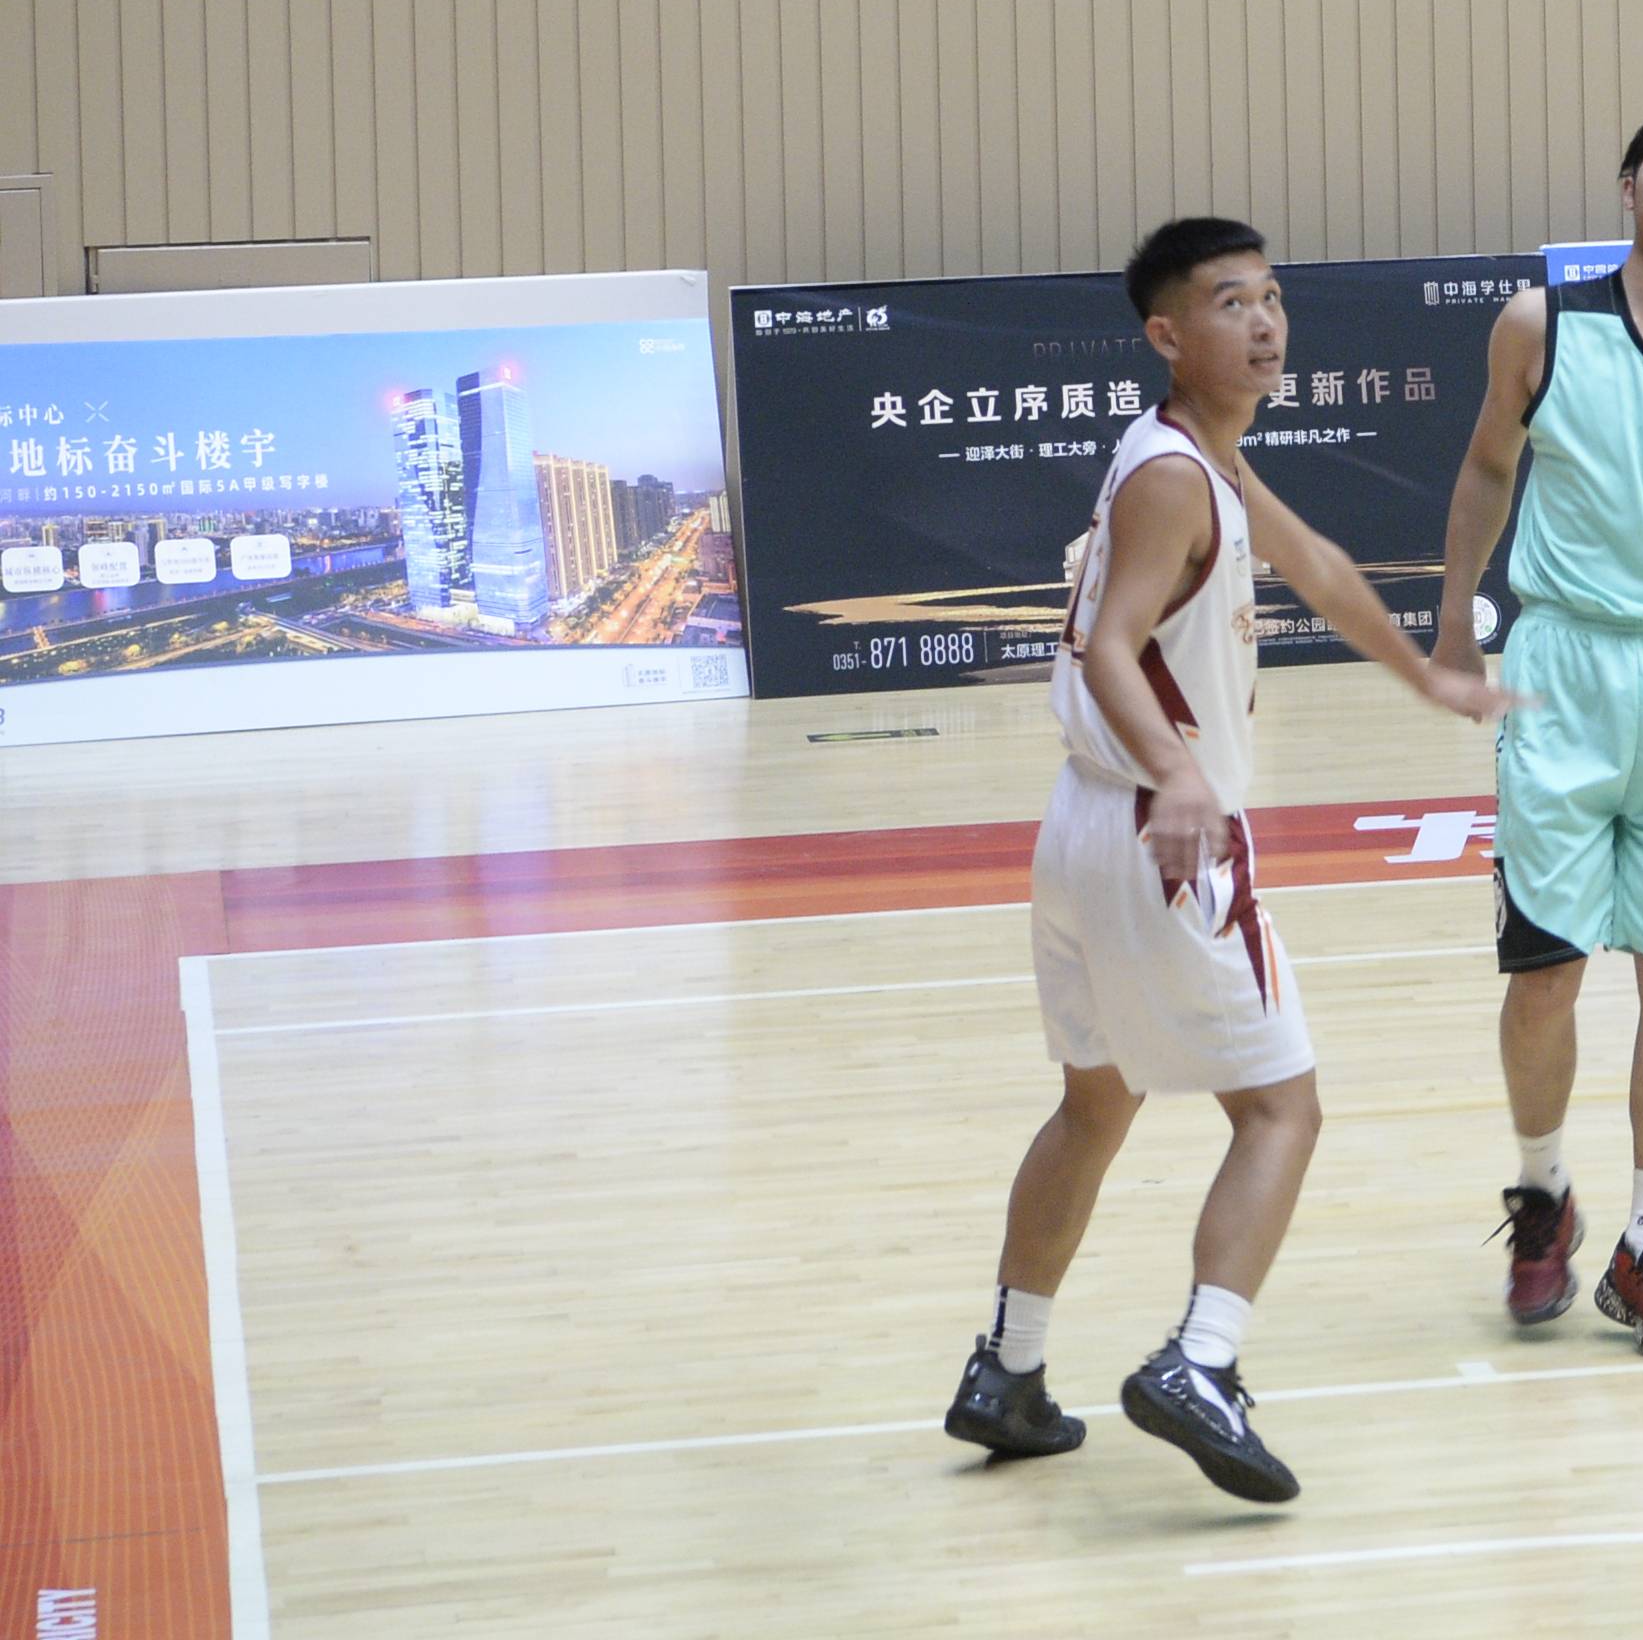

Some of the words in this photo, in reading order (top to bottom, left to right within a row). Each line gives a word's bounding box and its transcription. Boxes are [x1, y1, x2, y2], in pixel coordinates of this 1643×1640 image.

[774, 307, 854, 326] 中海地产
[870, 379, 1144, 429] 央企立序质造
[1267, 367, 1436, 410] 更新作品
[9, 427, 277, 478] 地标奋斗楼宇
[919, 632, 975, 666] 8888
